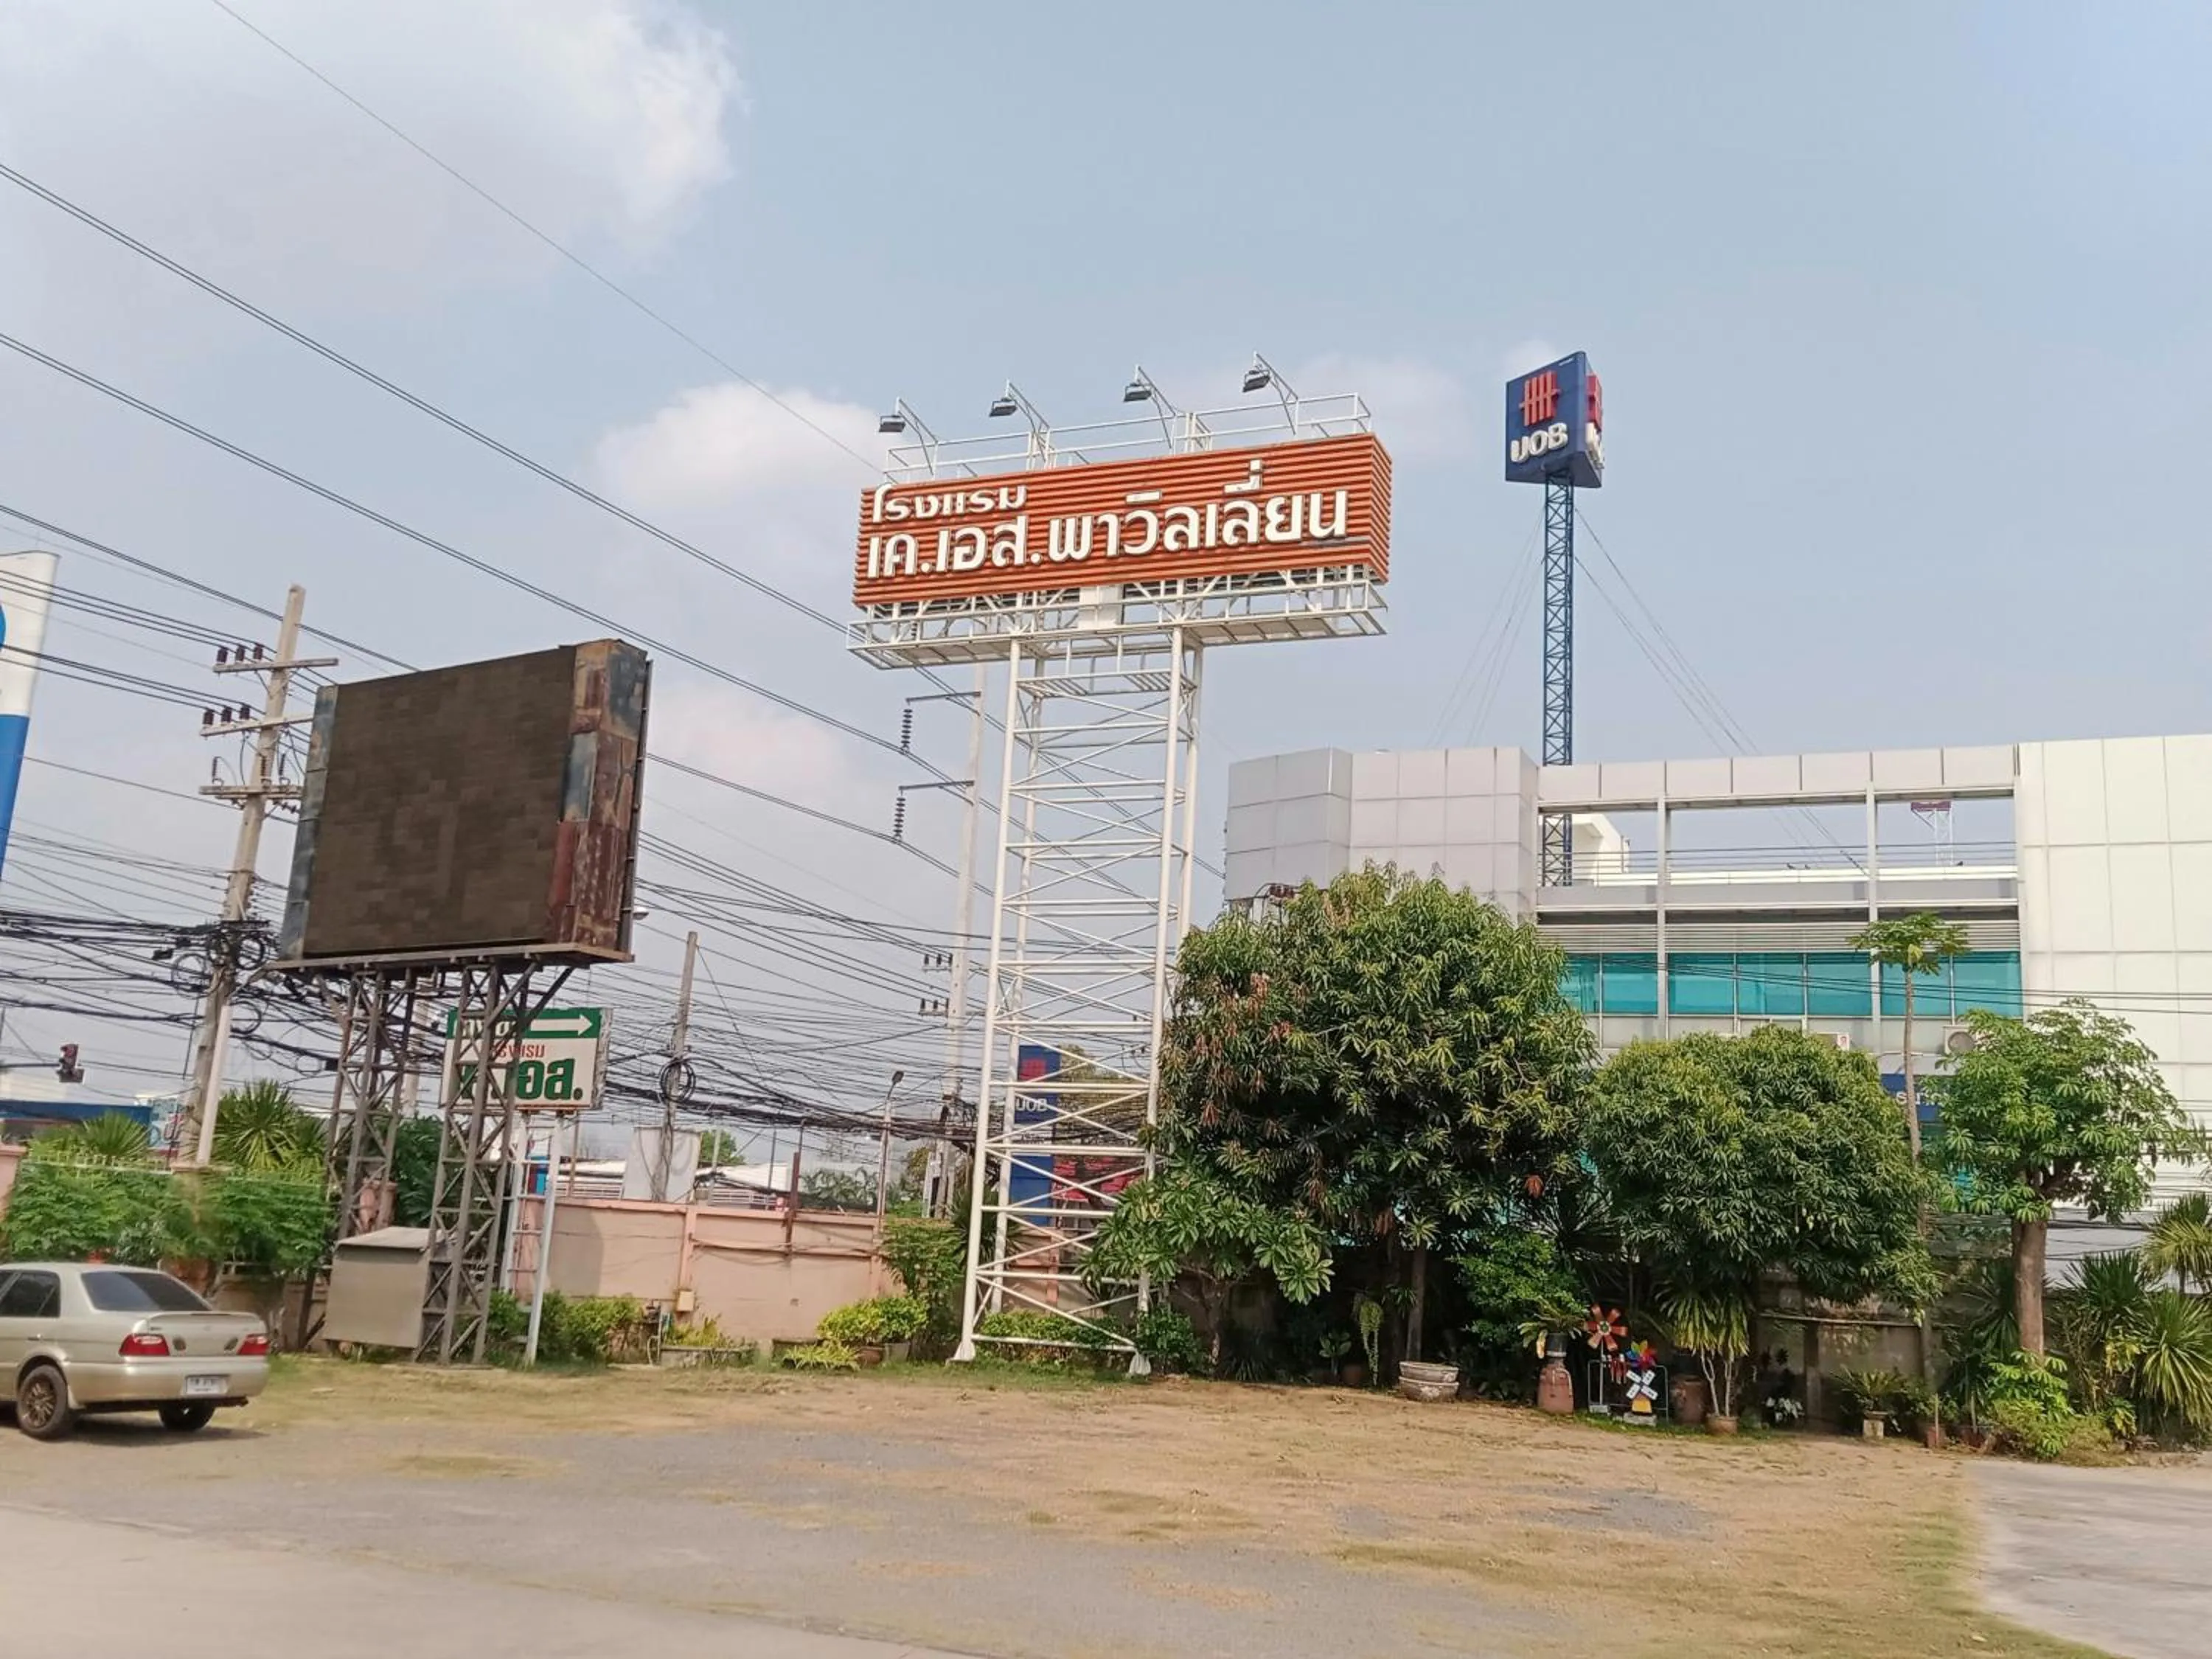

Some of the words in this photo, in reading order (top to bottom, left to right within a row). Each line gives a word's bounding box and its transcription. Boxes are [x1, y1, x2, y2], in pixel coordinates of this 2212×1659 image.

[1510, 422, 1569, 463] UOB
[872, 483, 1027, 524] โรงแรม
[1017, 1098, 1048, 1112] UOB
